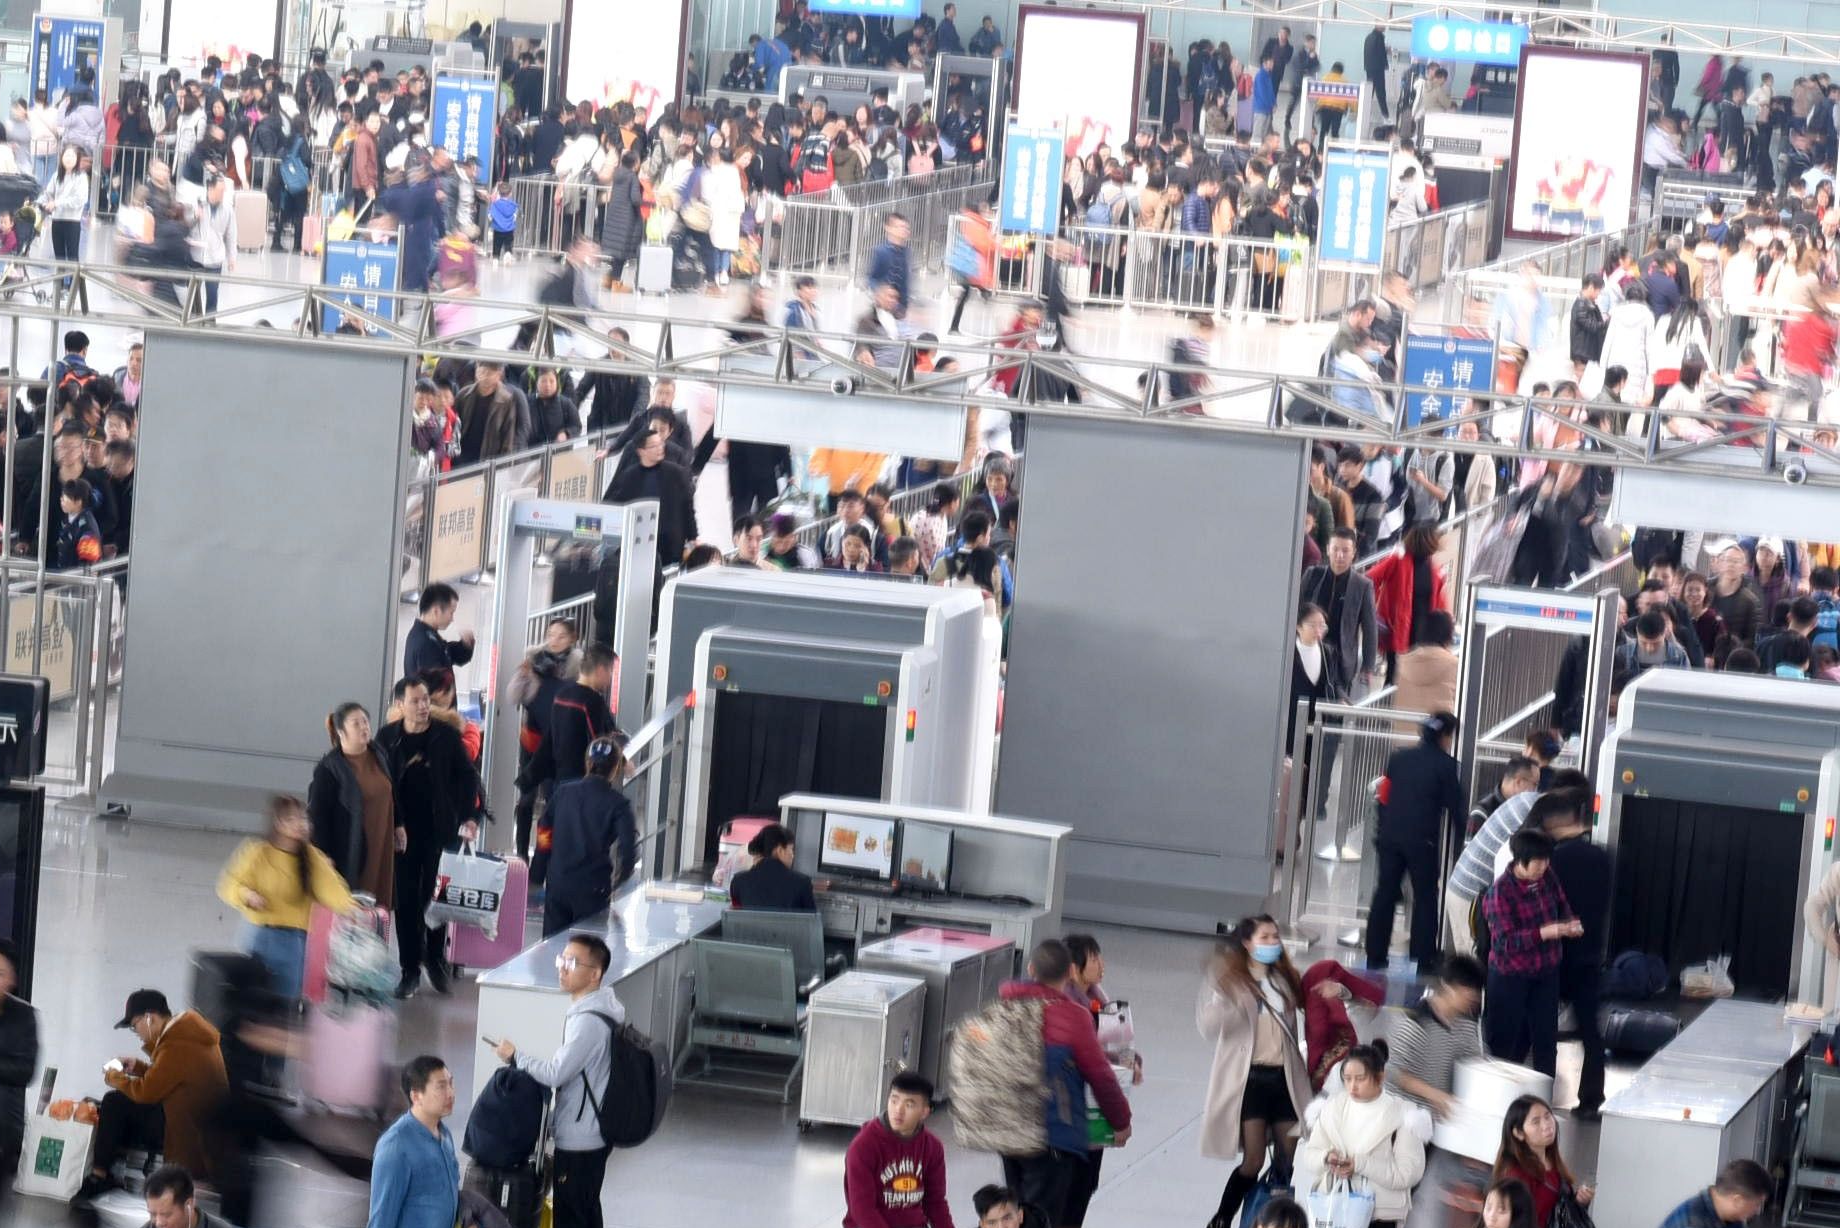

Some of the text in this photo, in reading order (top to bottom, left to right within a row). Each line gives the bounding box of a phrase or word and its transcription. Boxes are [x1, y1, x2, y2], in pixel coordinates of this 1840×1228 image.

[438, 507, 476, 539] 联邦高登
[883, 1191, 906, 1205] TEAM
